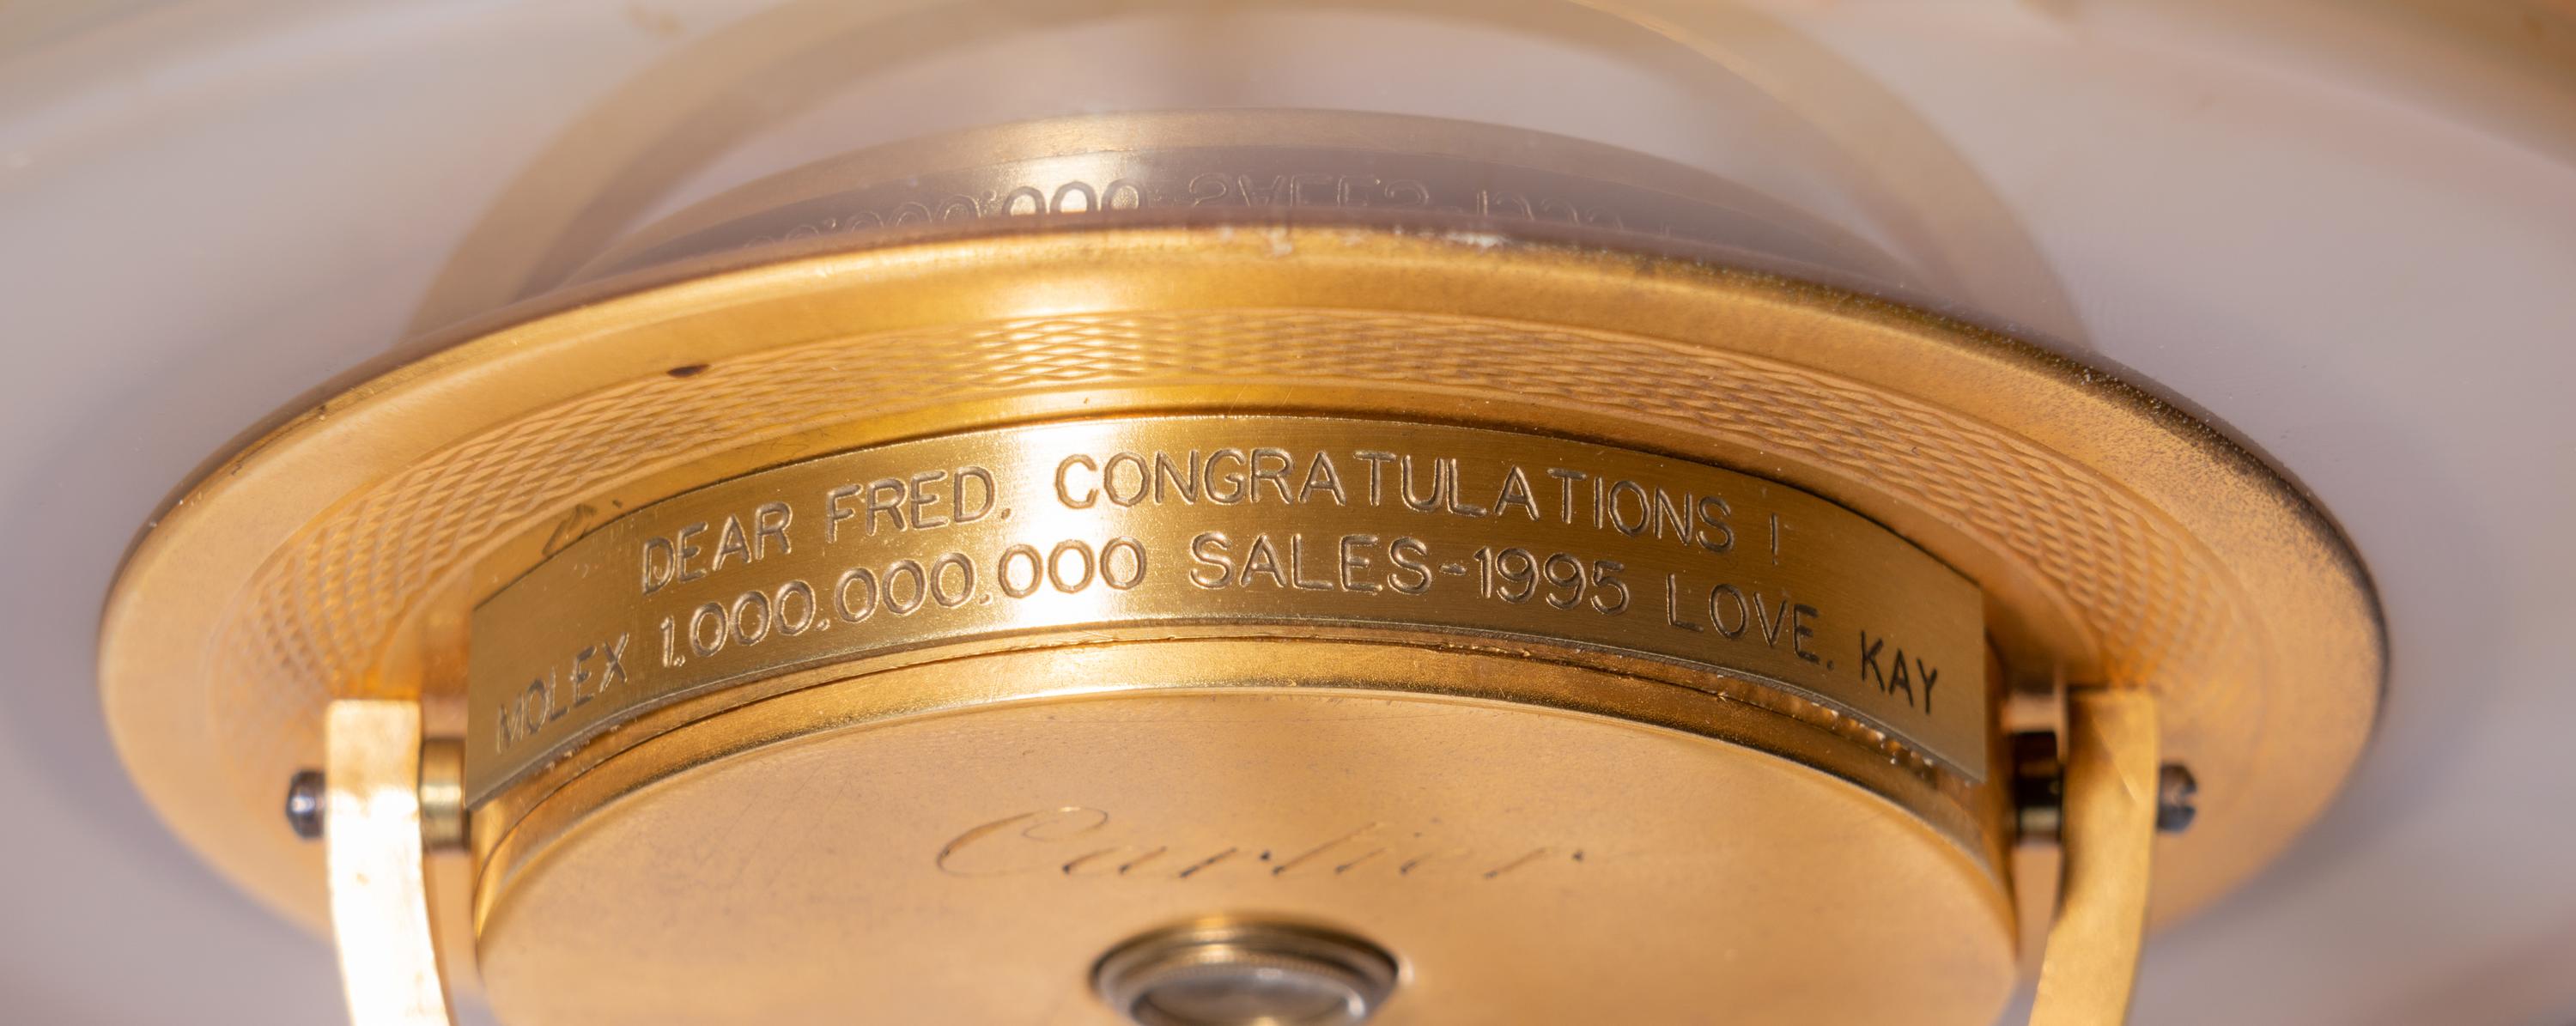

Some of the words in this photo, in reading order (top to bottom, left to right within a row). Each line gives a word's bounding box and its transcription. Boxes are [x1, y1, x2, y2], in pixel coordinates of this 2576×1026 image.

[641, 501, 793, 596] DEAR
[1054, 446, 1735, 553] CONGRATULATIONS
[495, 631, 631, 756] MOLEX
[1859, 628, 1940, 716] KAY
